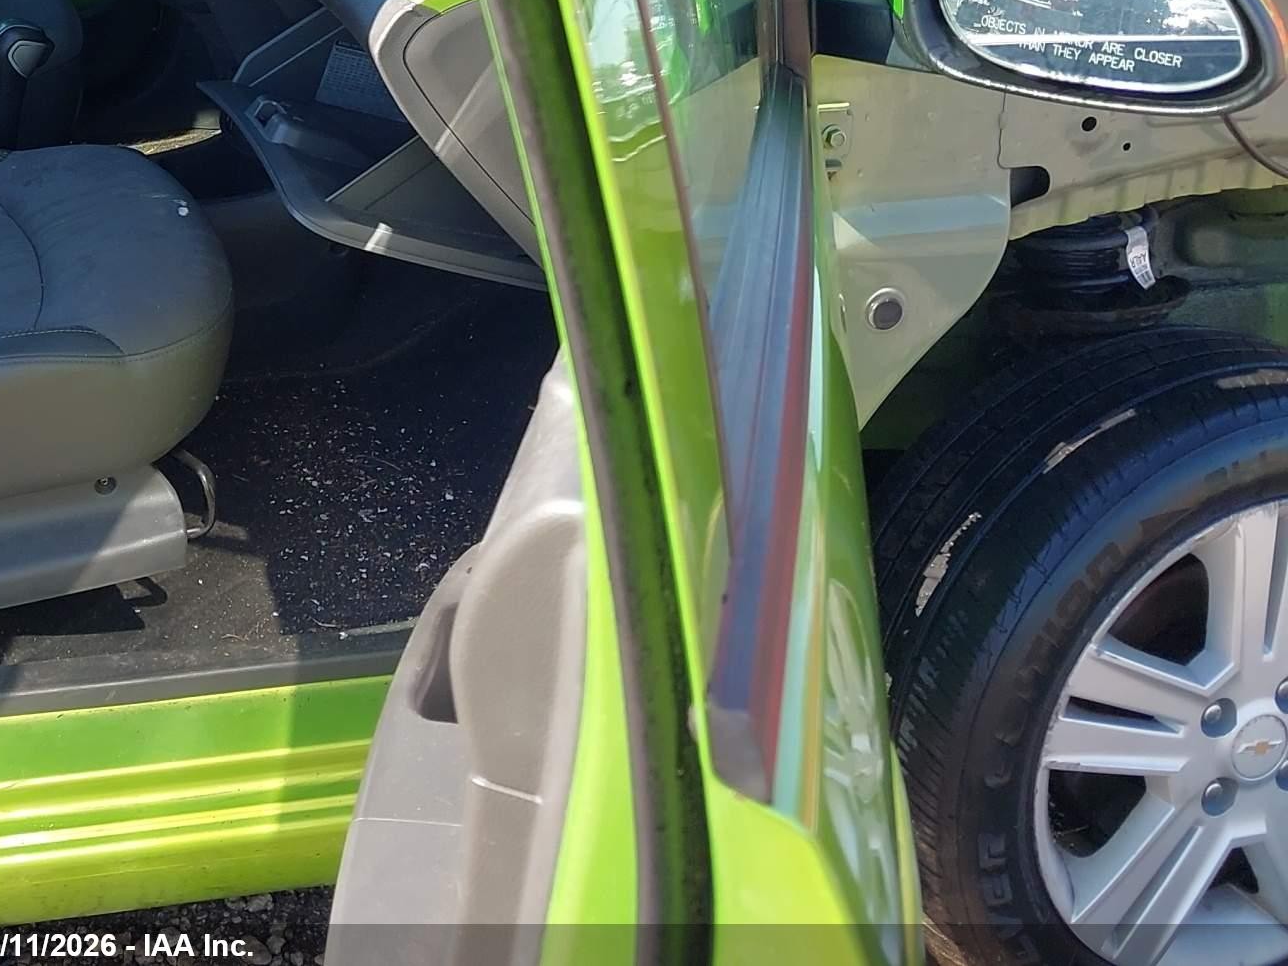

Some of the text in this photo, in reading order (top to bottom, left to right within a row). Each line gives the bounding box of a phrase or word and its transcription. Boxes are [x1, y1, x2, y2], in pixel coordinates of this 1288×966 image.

[980, 14, 1027, 35] OBJECTS
[1053, 30, 1094, 50] ROR
[1101, 41, 1125, 57] ARE
[1134, 47, 1183, 68] CLOSER
[1052, 43, 1082, 60] THEY
[1088, 52, 1135, 72] APPEAR
